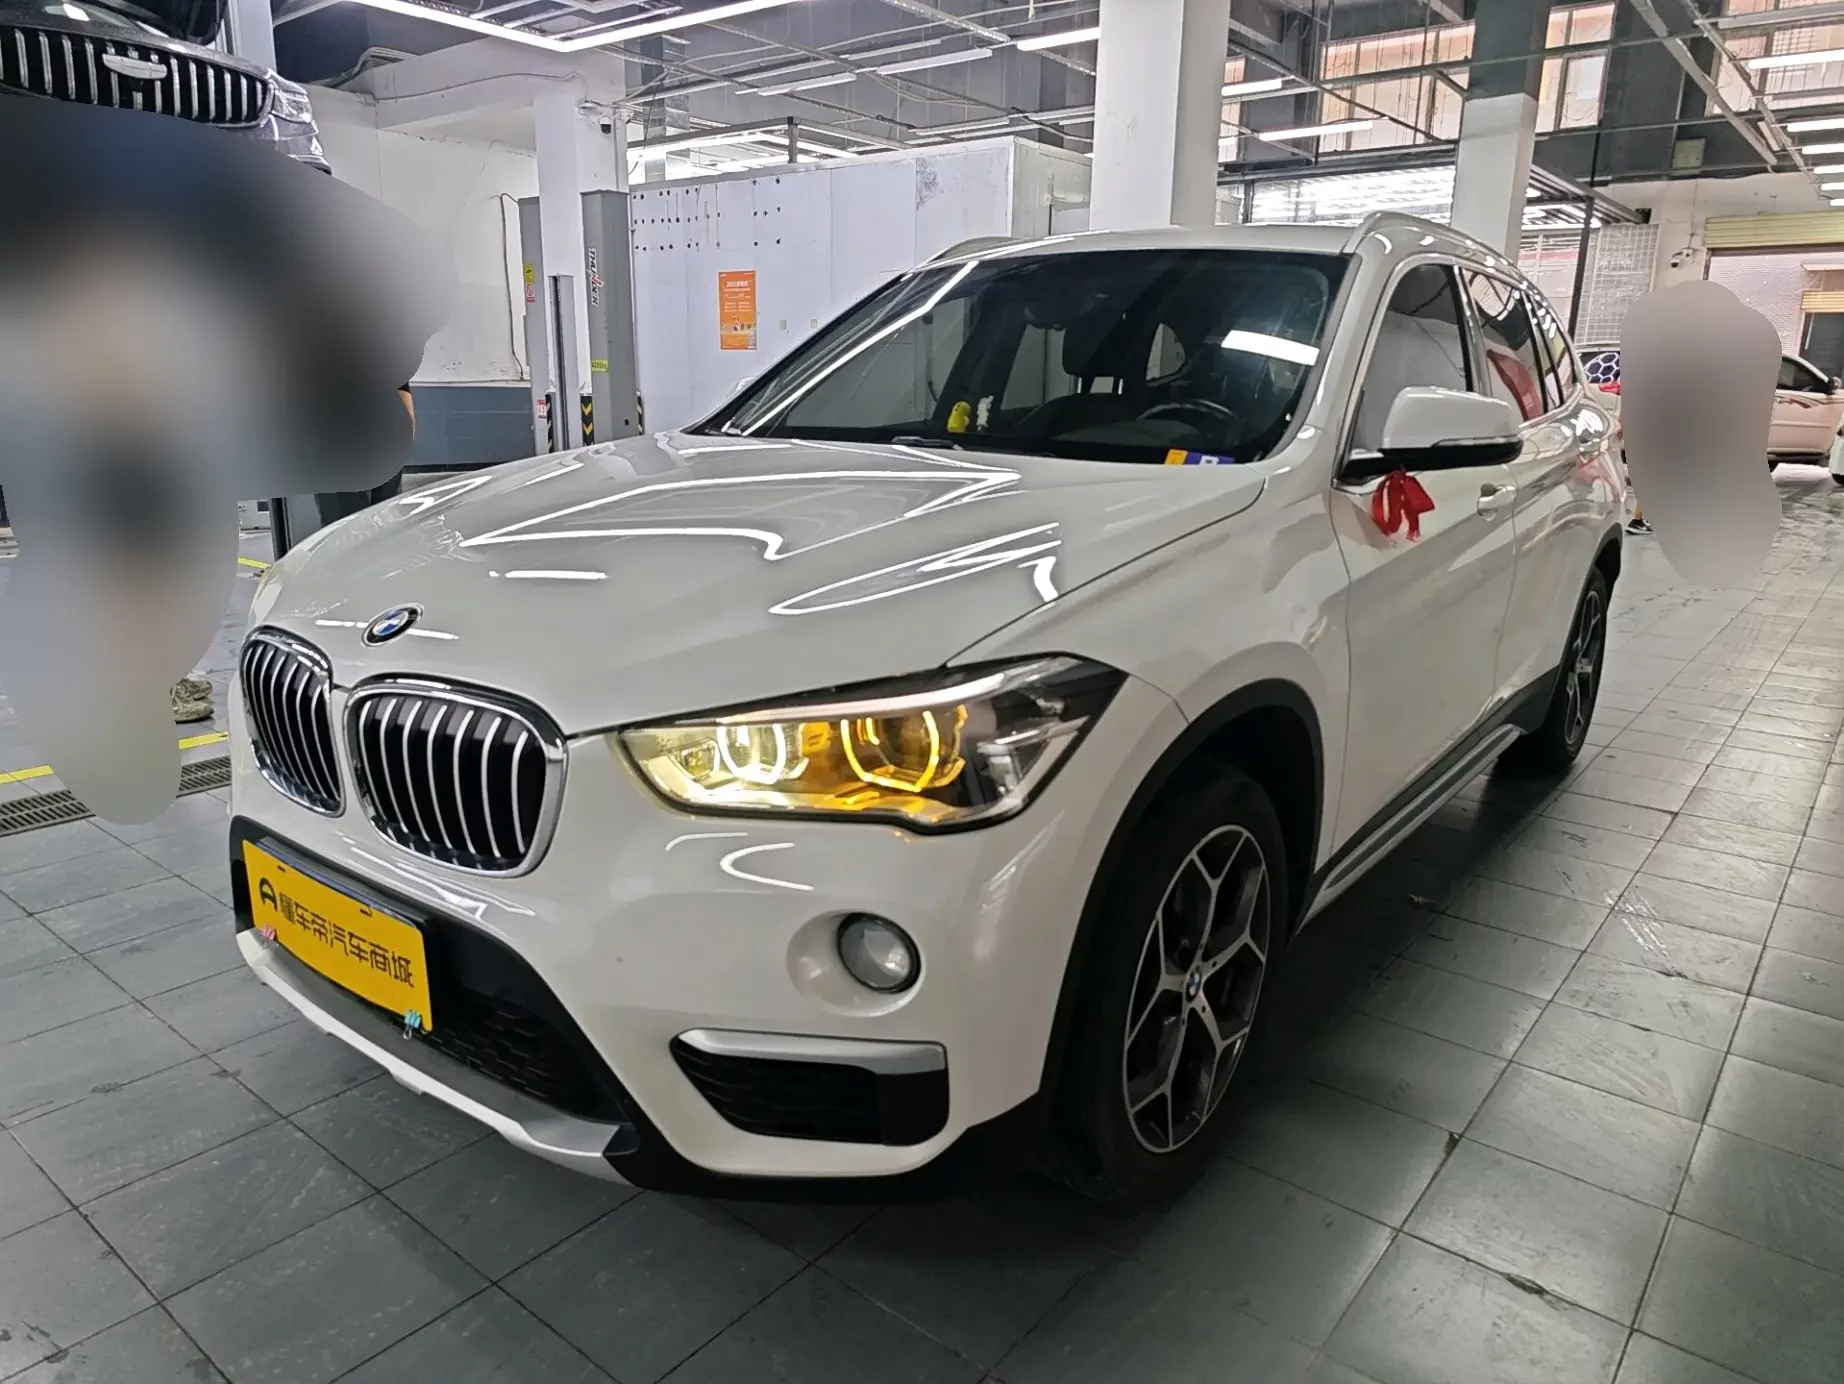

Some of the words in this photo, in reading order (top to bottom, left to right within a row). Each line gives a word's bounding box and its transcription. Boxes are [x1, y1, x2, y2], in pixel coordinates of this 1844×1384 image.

[588, 249, 603, 306] THUNDER
[279, 892, 415, 988] 懂车帝汽车商城
